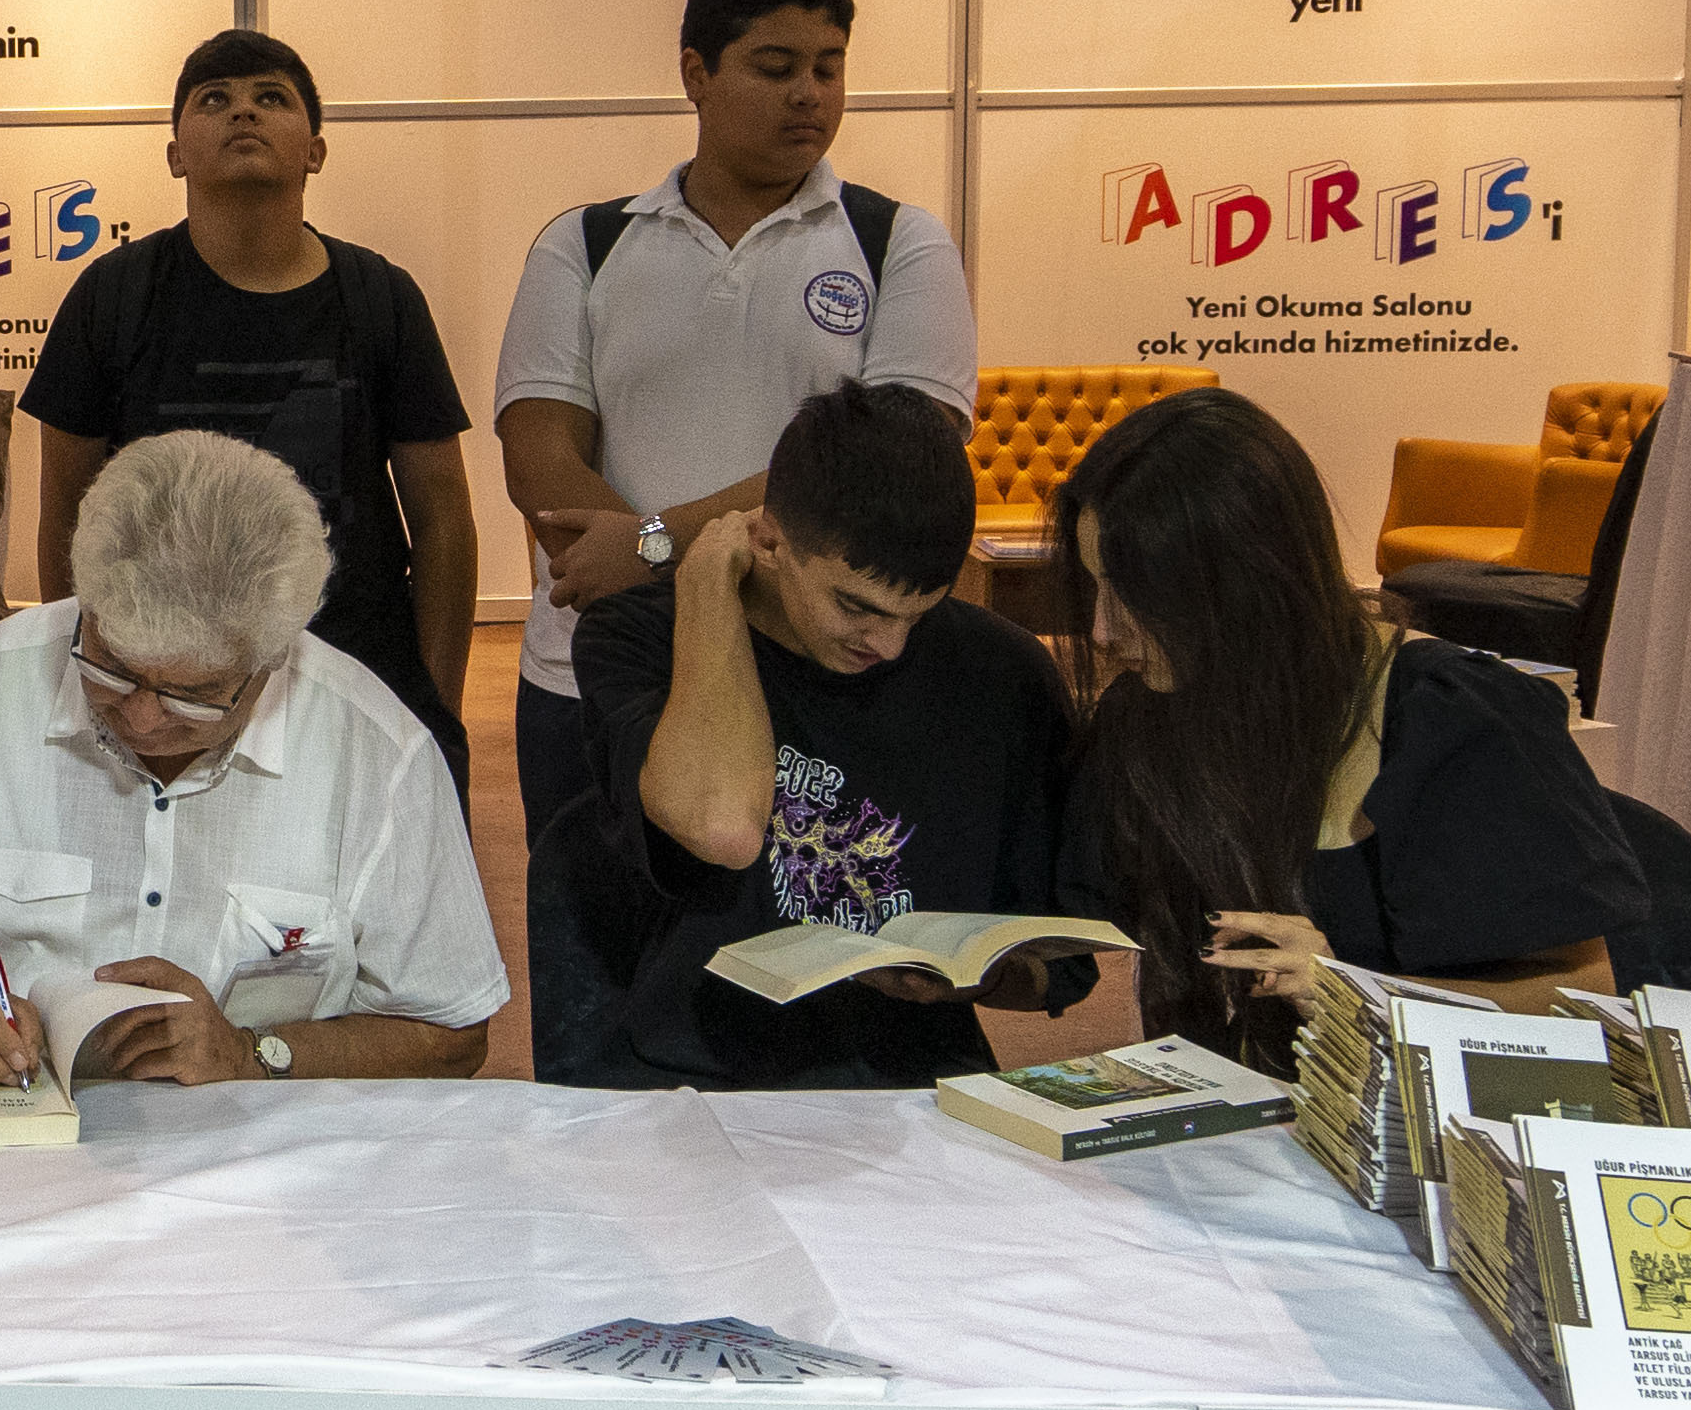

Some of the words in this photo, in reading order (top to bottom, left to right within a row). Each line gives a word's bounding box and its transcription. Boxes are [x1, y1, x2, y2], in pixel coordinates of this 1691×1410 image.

[1101, 157, 1564, 268] ADRES'i
[1186, 294, 1248, 319] Yeni
[1256, 294, 1364, 319] Okuma
[1372, 292, 1473, 317] Salonu
[1137, 331, 1188, 361] çok
[1197, 328, 1317, 362] yakında
[1325, 326, 1519, 354] hizmetinizde.
[1460, 1039, 1487, 1051] UĞUR
[1490, 1040, 1548, 1055] PİŞMANLIK
[1594, 1159, 1626, 1174] UĞUR
[1628, 1337, 1659, 1348] ANTİK
[1663, 1339, 1683, 1351] ÇAĞ
[1631, 1349, 1670, 1362] TARSUS
[1633, 1363, 1665, 1374] ATLET
[1635, 1376, 1648, 1386] VE
[1638, 1388, 1678, 1400] TARSUS
